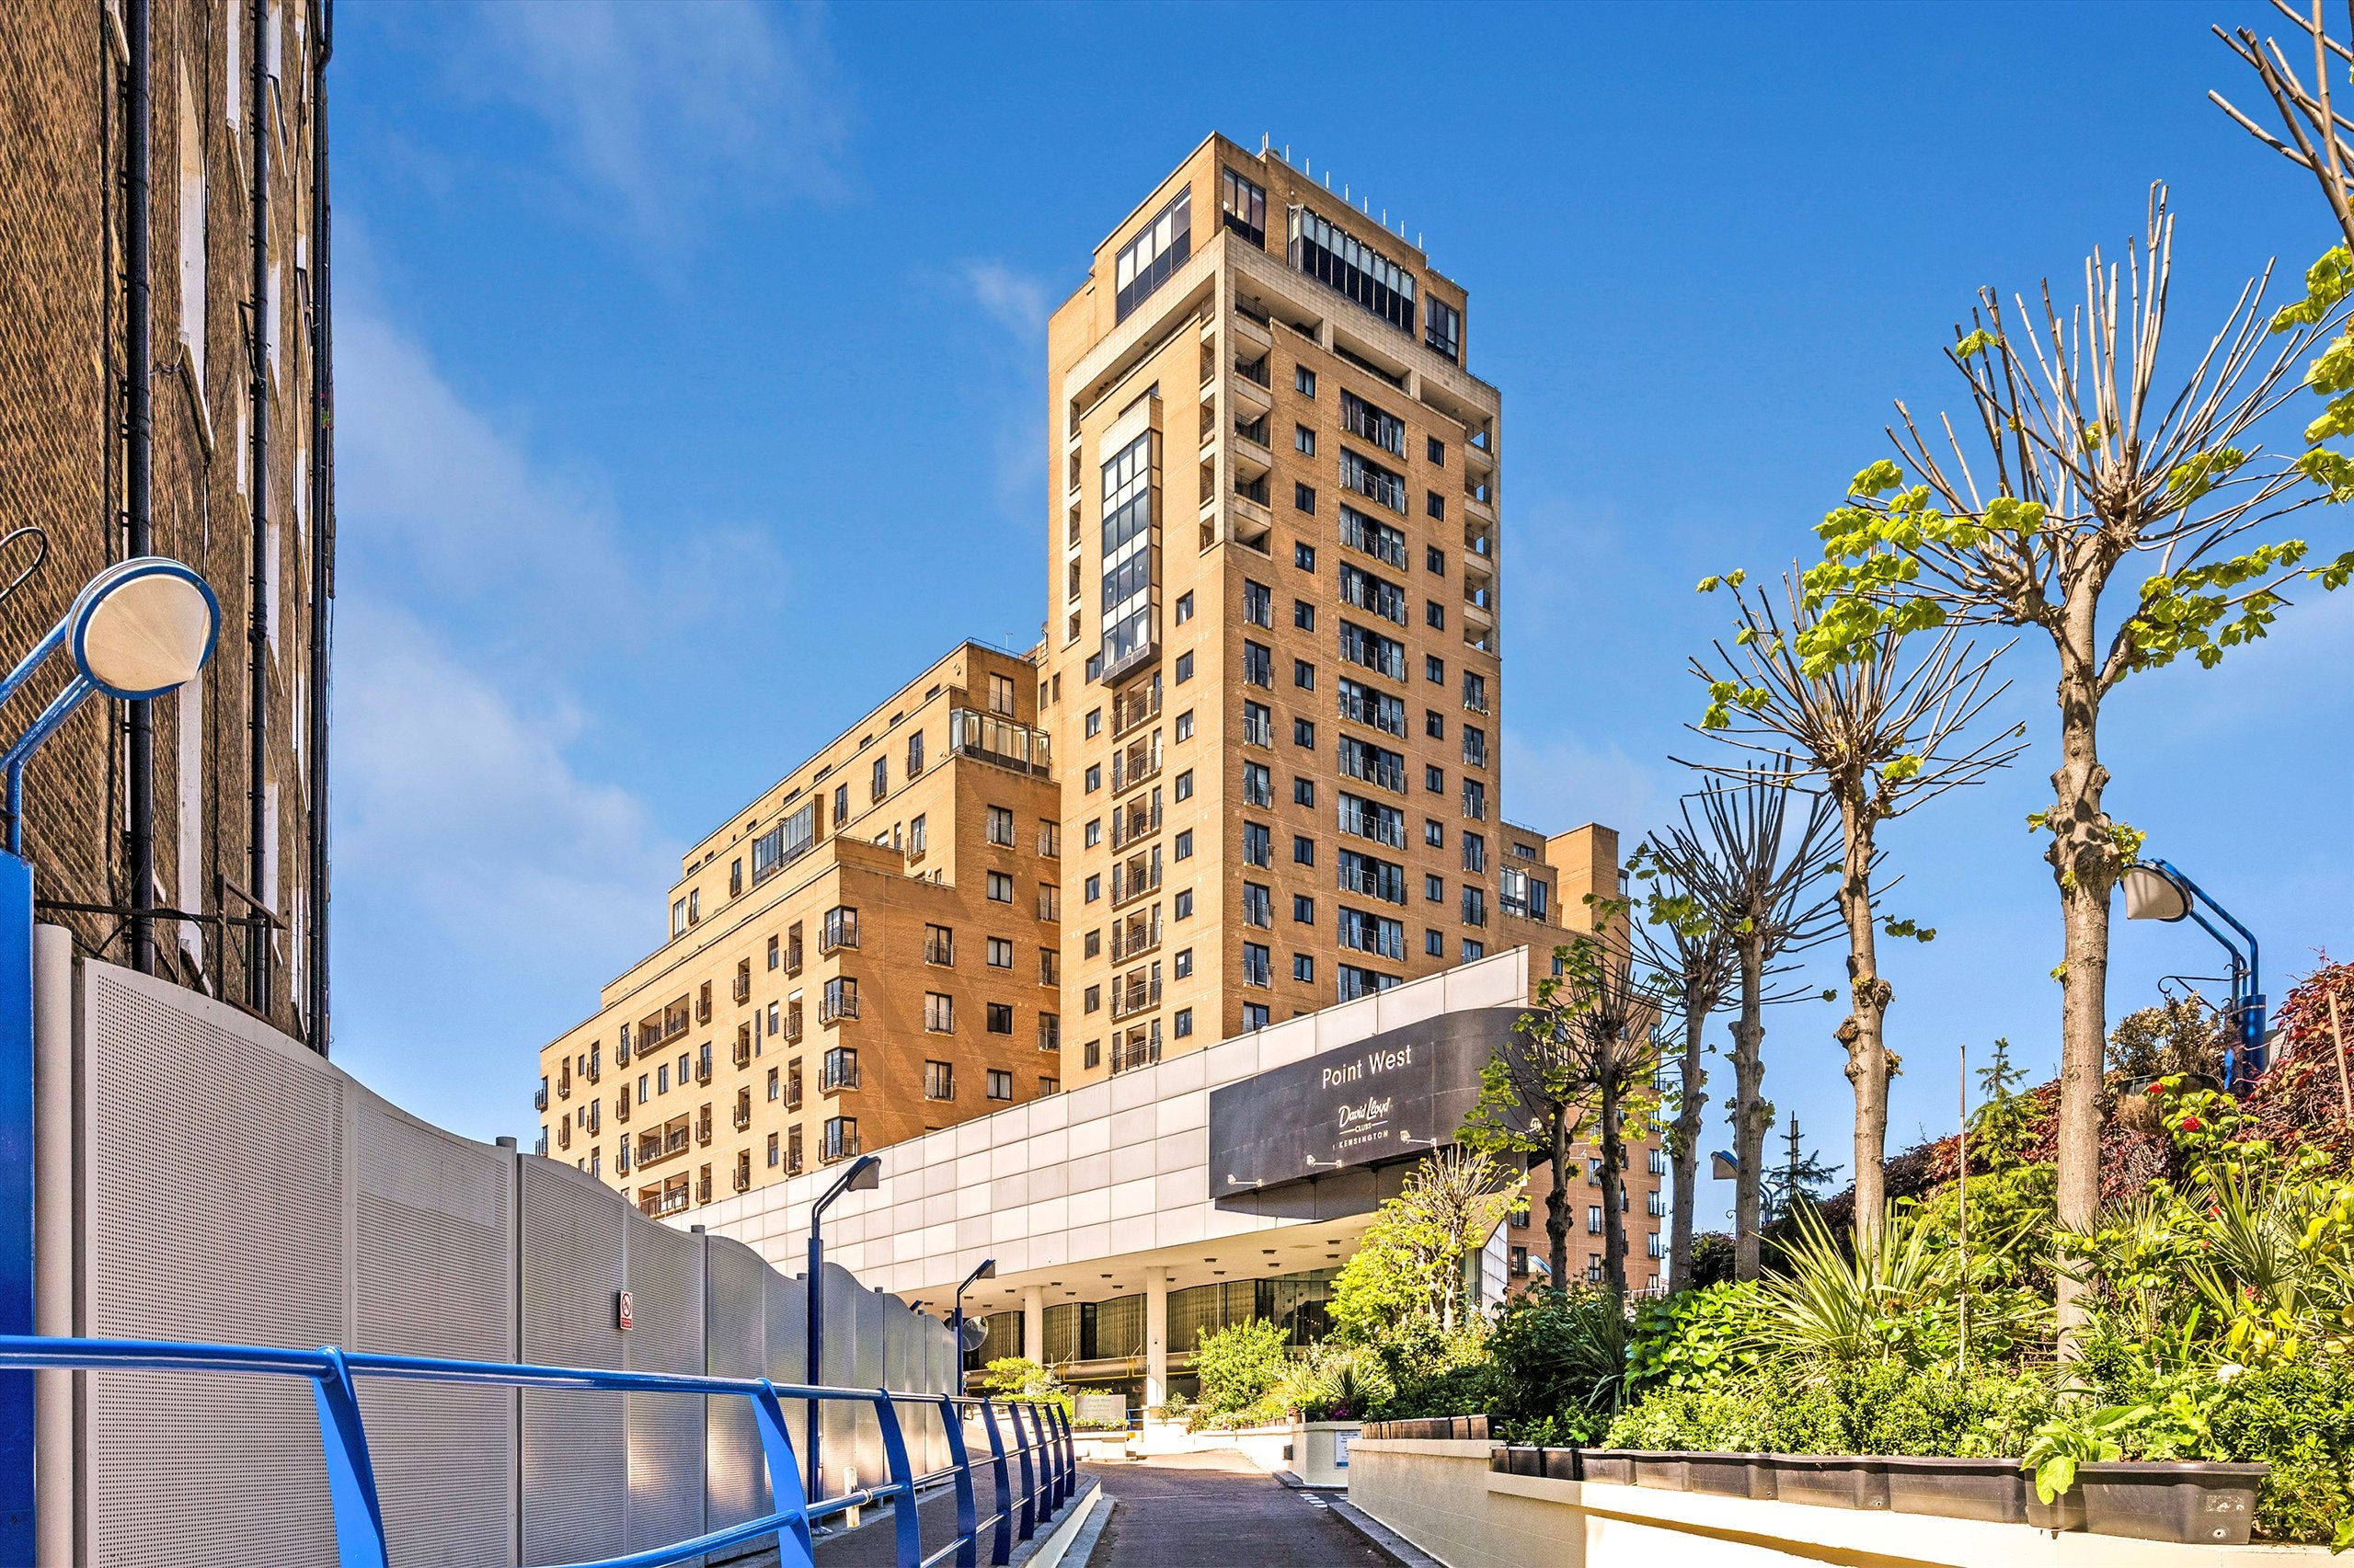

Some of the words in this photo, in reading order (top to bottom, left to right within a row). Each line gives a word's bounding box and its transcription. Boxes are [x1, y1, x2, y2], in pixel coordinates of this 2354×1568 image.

[1323, 1059, 1361, 1089] Point
[1368, 1045, 1411, 1074] West
[1338, 1104, 1367, 1128] David
[1367, 1096, 1391, 1120] Lloyd
[1338, 1130, 1389, 1149] KENSINGTON
[1354, 1122, 1372, 1133] CLUBS
